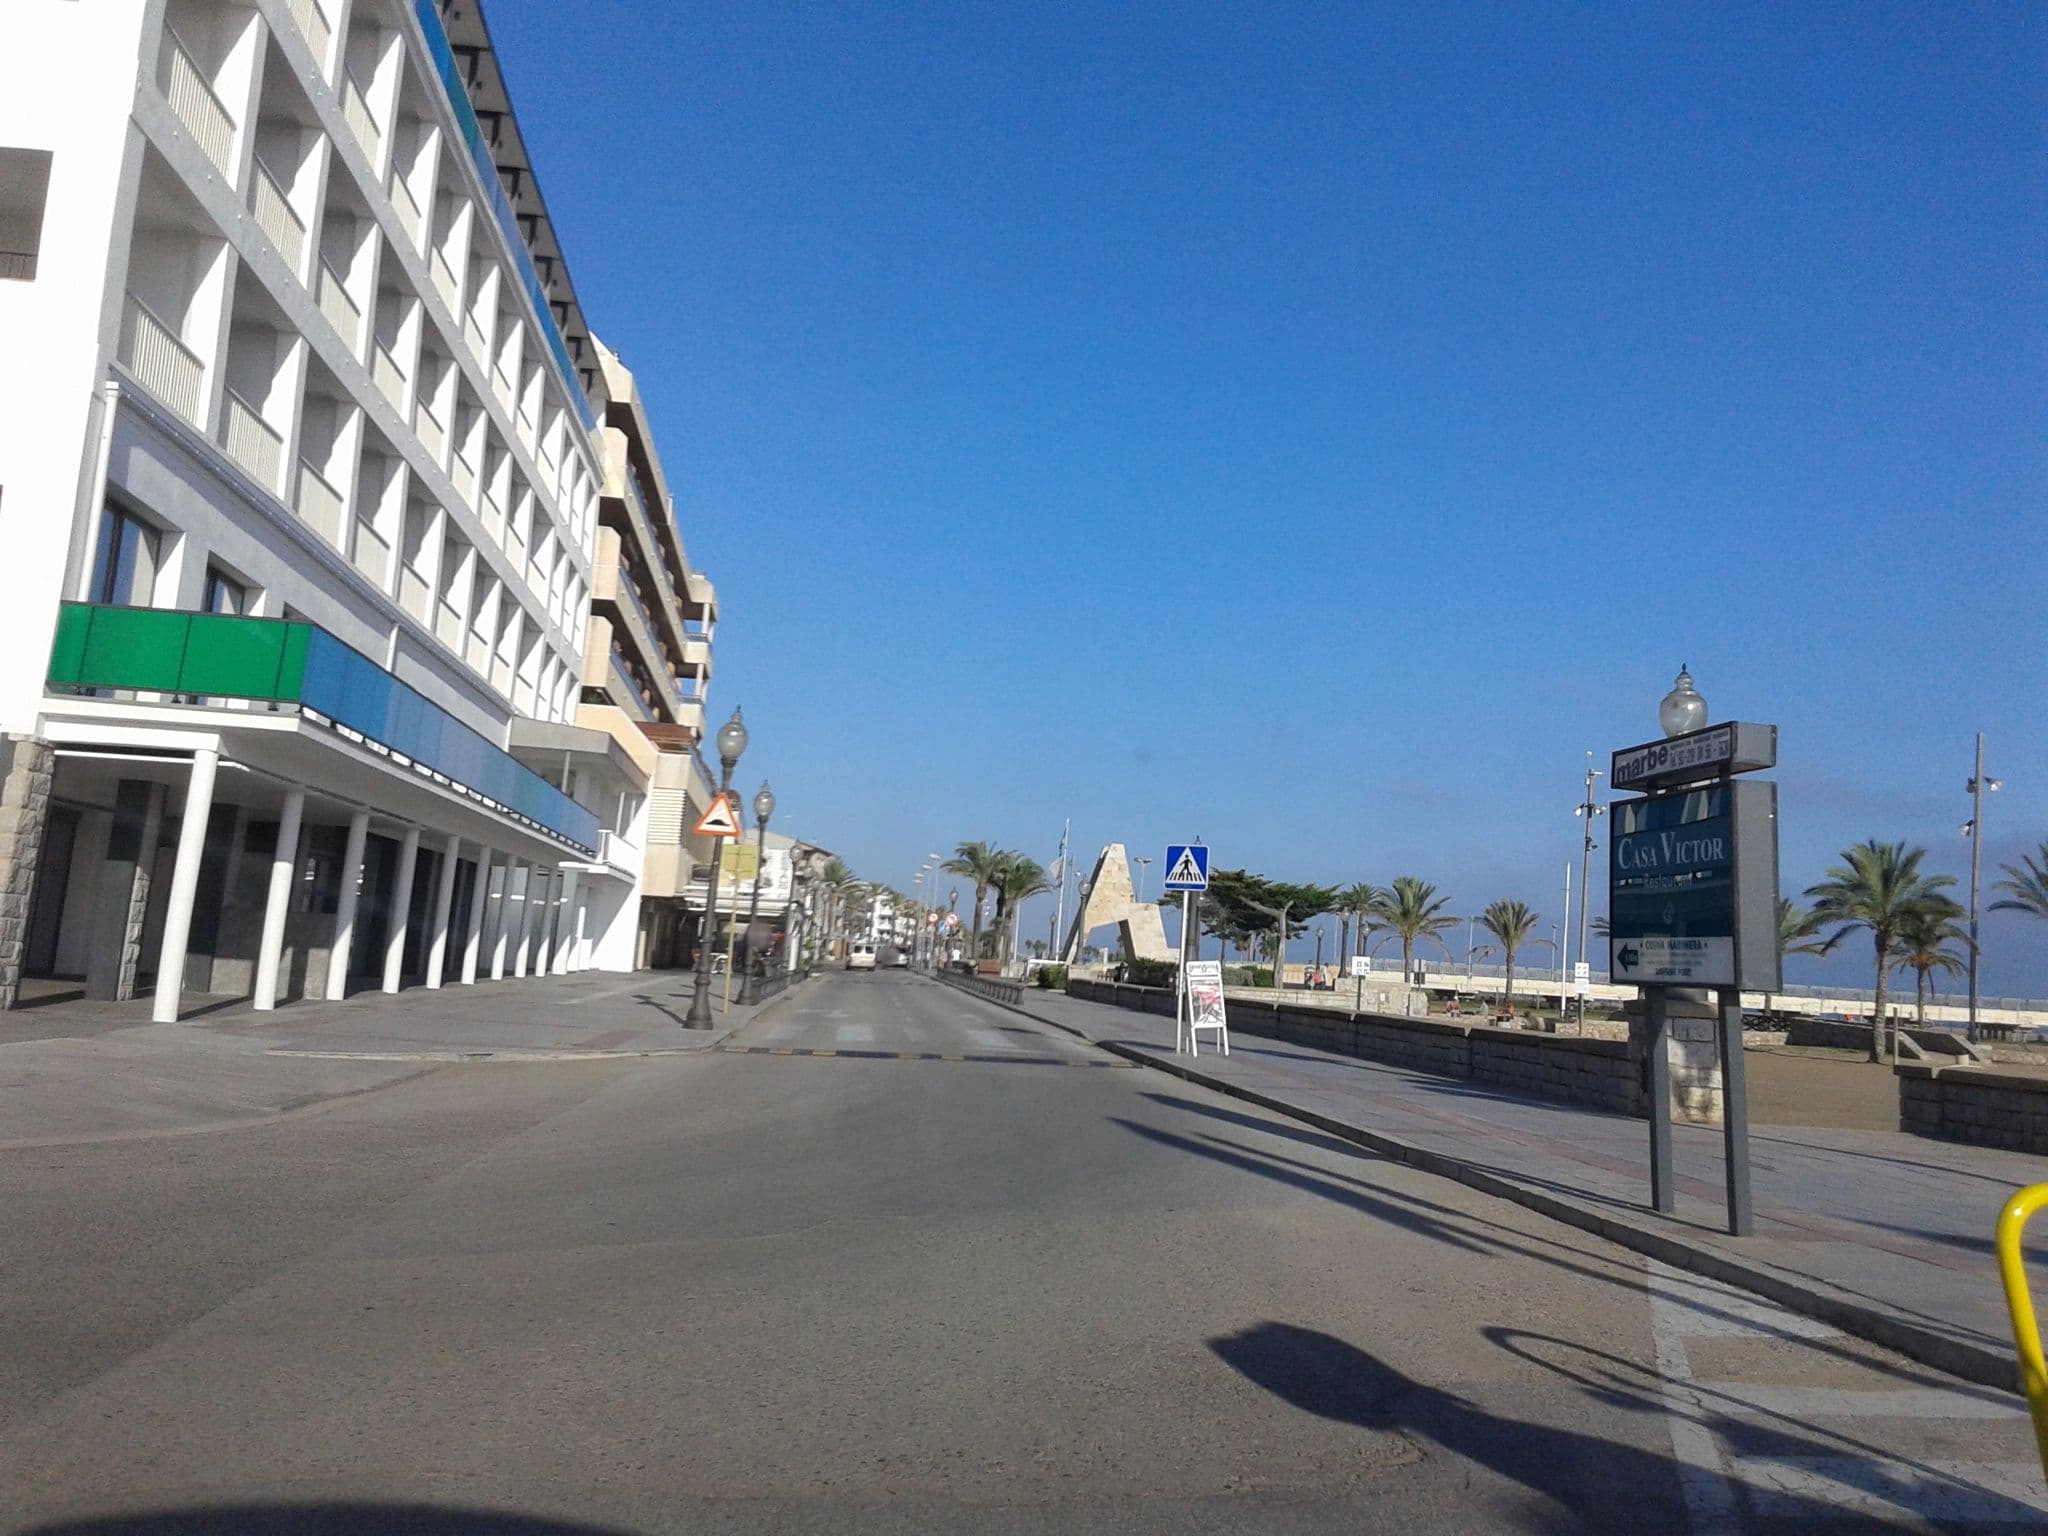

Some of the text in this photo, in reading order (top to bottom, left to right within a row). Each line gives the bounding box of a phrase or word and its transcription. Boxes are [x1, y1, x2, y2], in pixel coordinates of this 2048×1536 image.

[1616, 746, 1669, 784] marbe
[1618, 831, 1724, 870] CASA VICTOR
